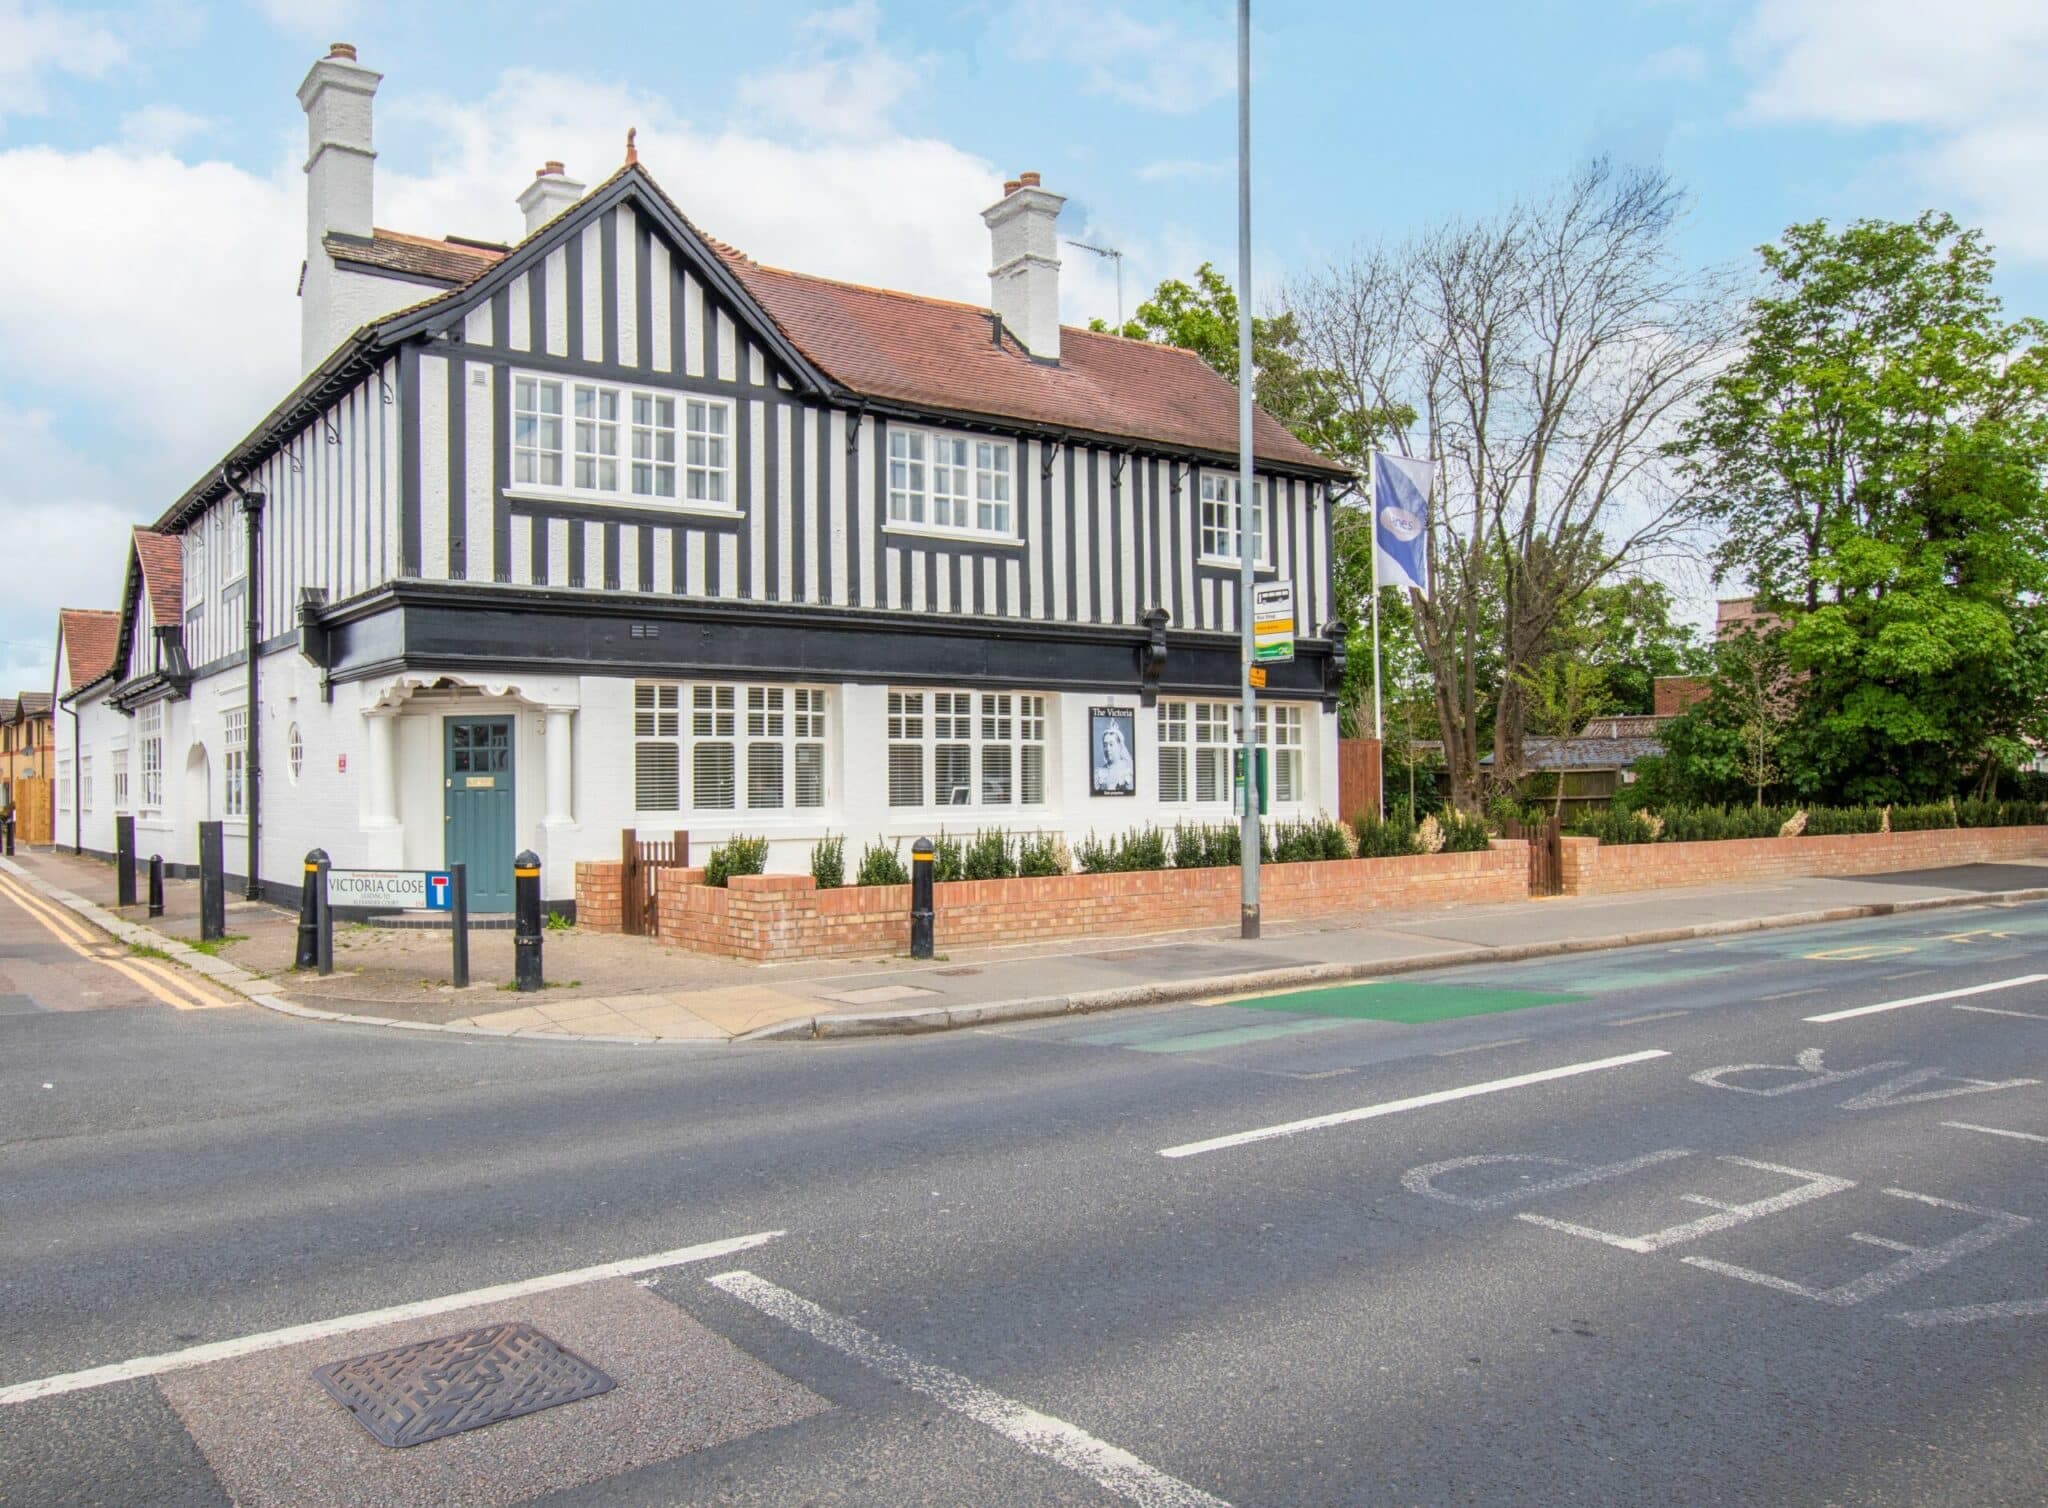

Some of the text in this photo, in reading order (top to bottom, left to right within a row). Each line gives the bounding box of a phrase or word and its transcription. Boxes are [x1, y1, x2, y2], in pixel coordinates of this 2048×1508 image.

[1093, 707, 1132, 717] The Victoria
[329, 878, 425, 893] VICTORIA CLOSE
